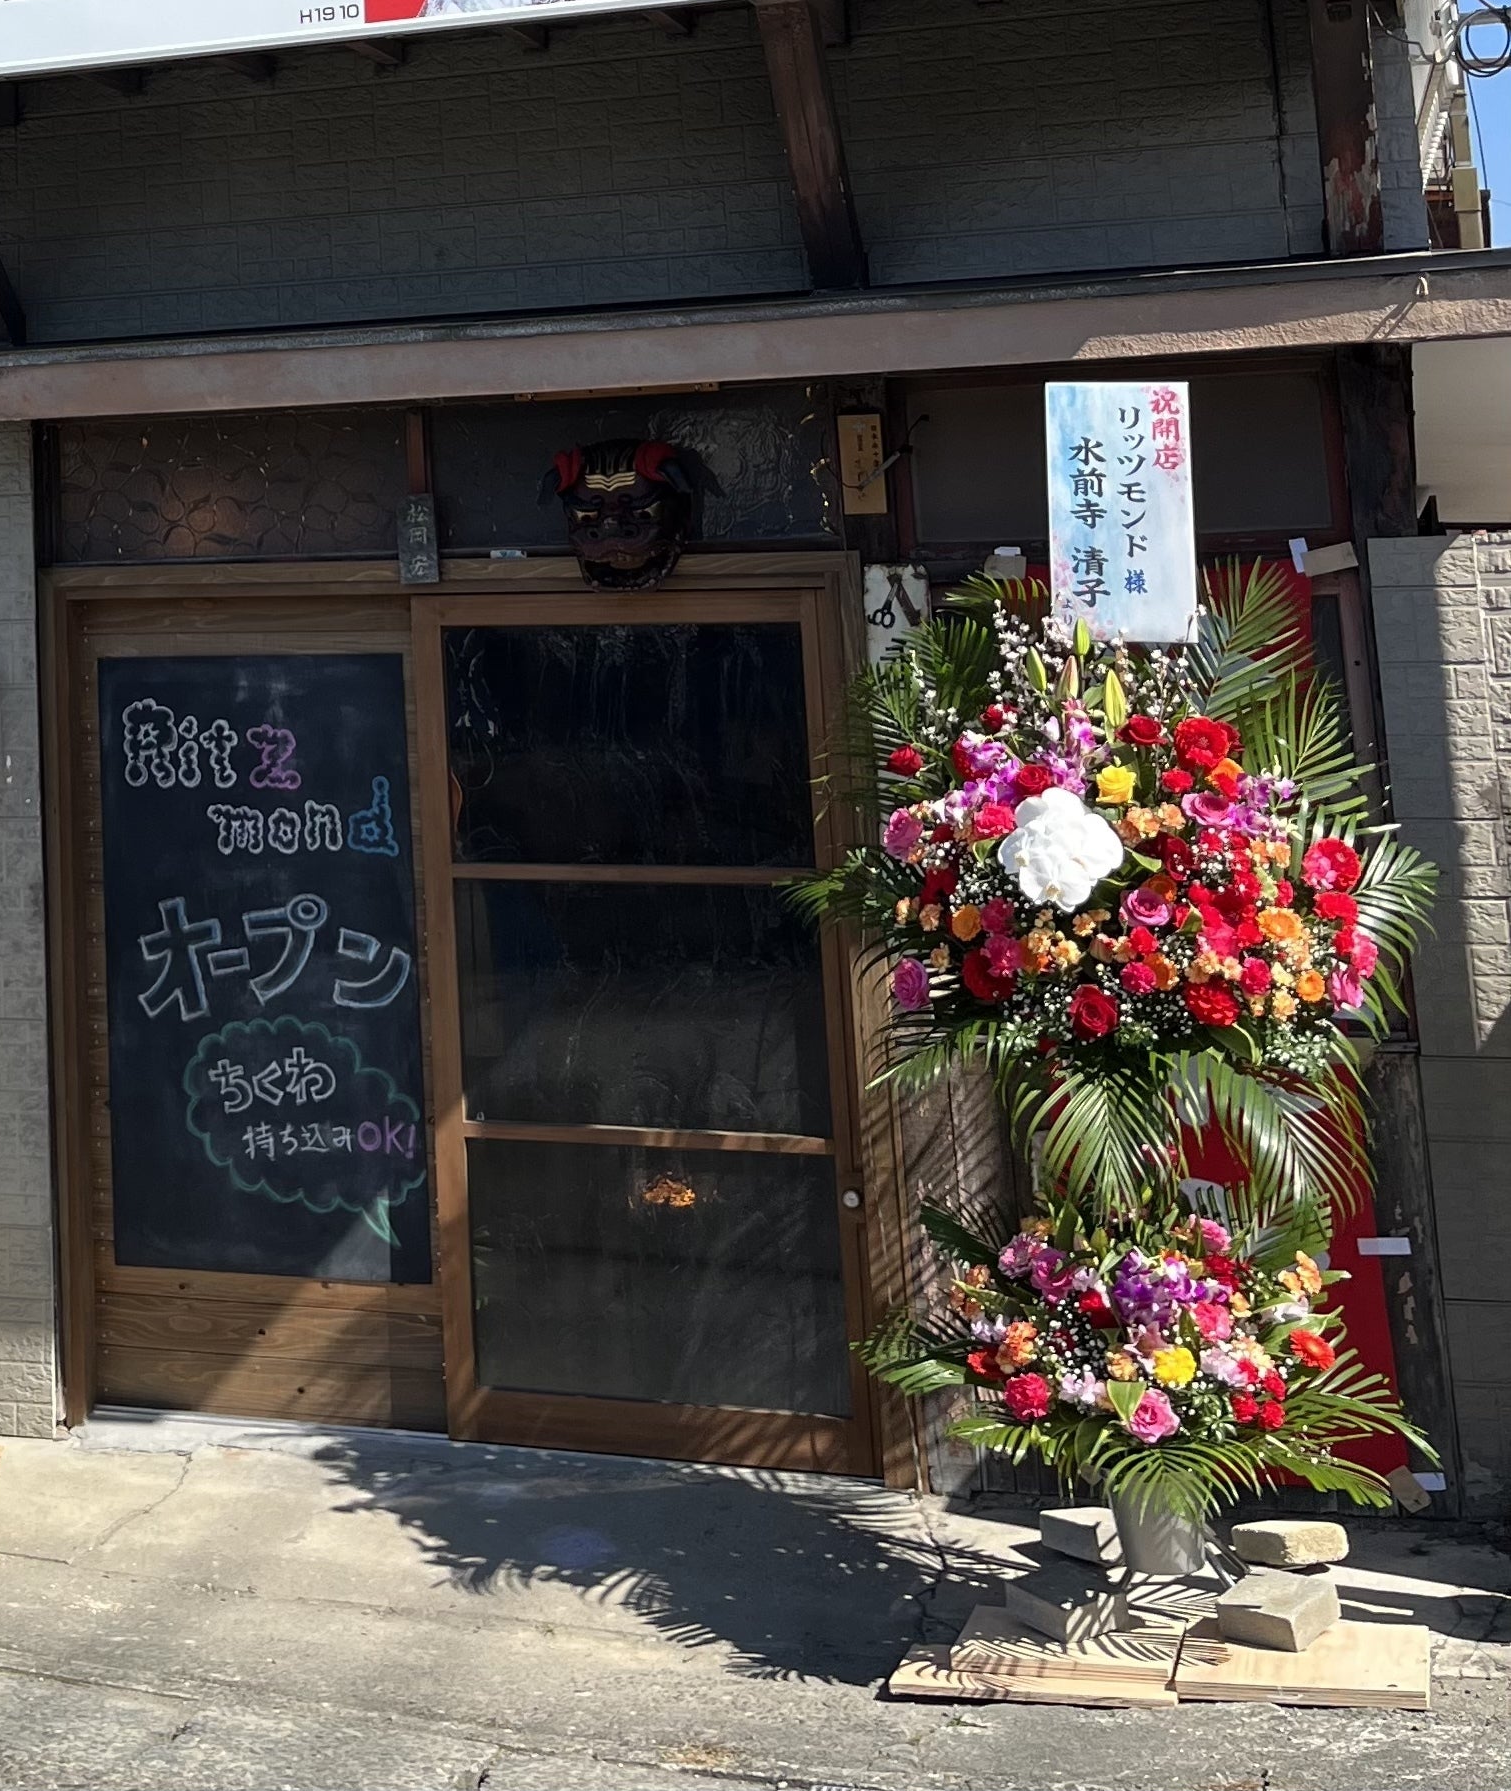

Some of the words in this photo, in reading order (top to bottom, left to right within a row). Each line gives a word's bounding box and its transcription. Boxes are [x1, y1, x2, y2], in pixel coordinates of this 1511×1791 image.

[1150, 389, 1180, 471] 祝開店
[138, 892, 413, 1022] オープン
[208, 1046, 337, 1115] ちくわ
